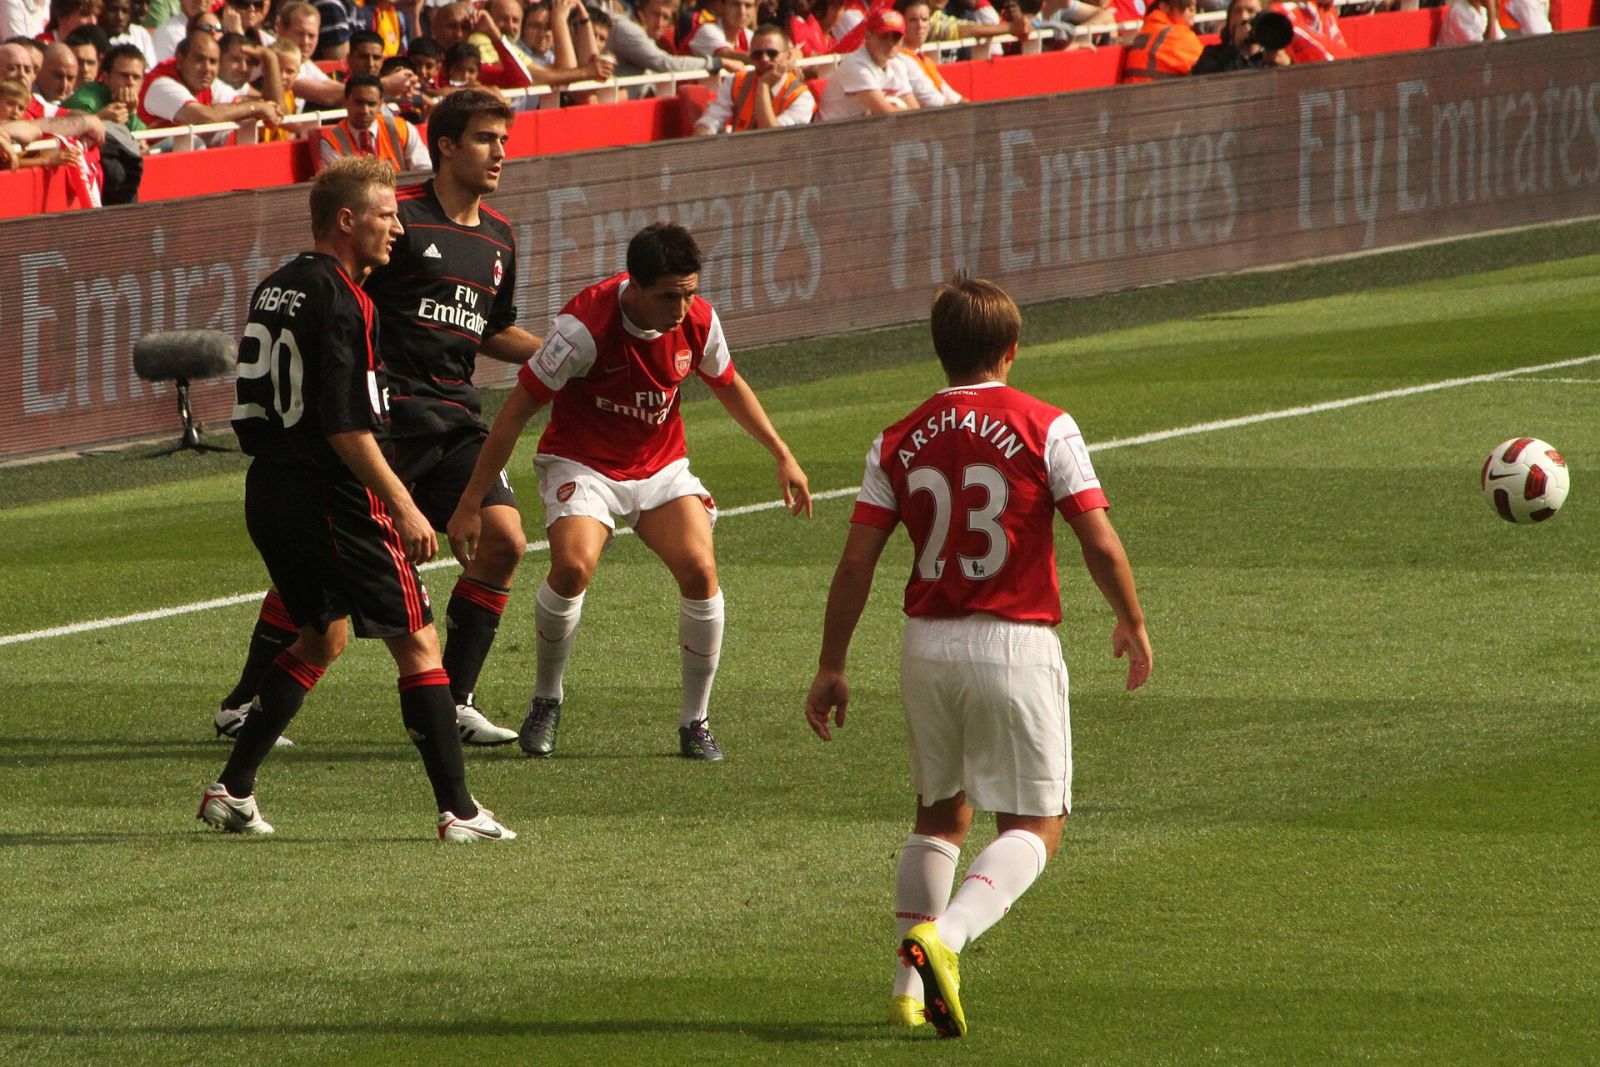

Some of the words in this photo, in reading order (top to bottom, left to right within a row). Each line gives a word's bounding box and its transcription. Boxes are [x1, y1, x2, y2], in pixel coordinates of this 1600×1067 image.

[890, 138, 987, 289] Fly
[1000, 111, 1238, 273] Emirates
[1299, 90, 1385, 248] Fly
[1397, 63, 1600, 212] Emirates
[19, 225, 301, 414] Emirat
[454, 284, 479, 309] Fly
[231, 322, 305, 429] 20
[635, 391, 667, 407] Fly
[897, 407, 1025, 469] ARSHAVIN
[905, 463, 1010, 581] 23
